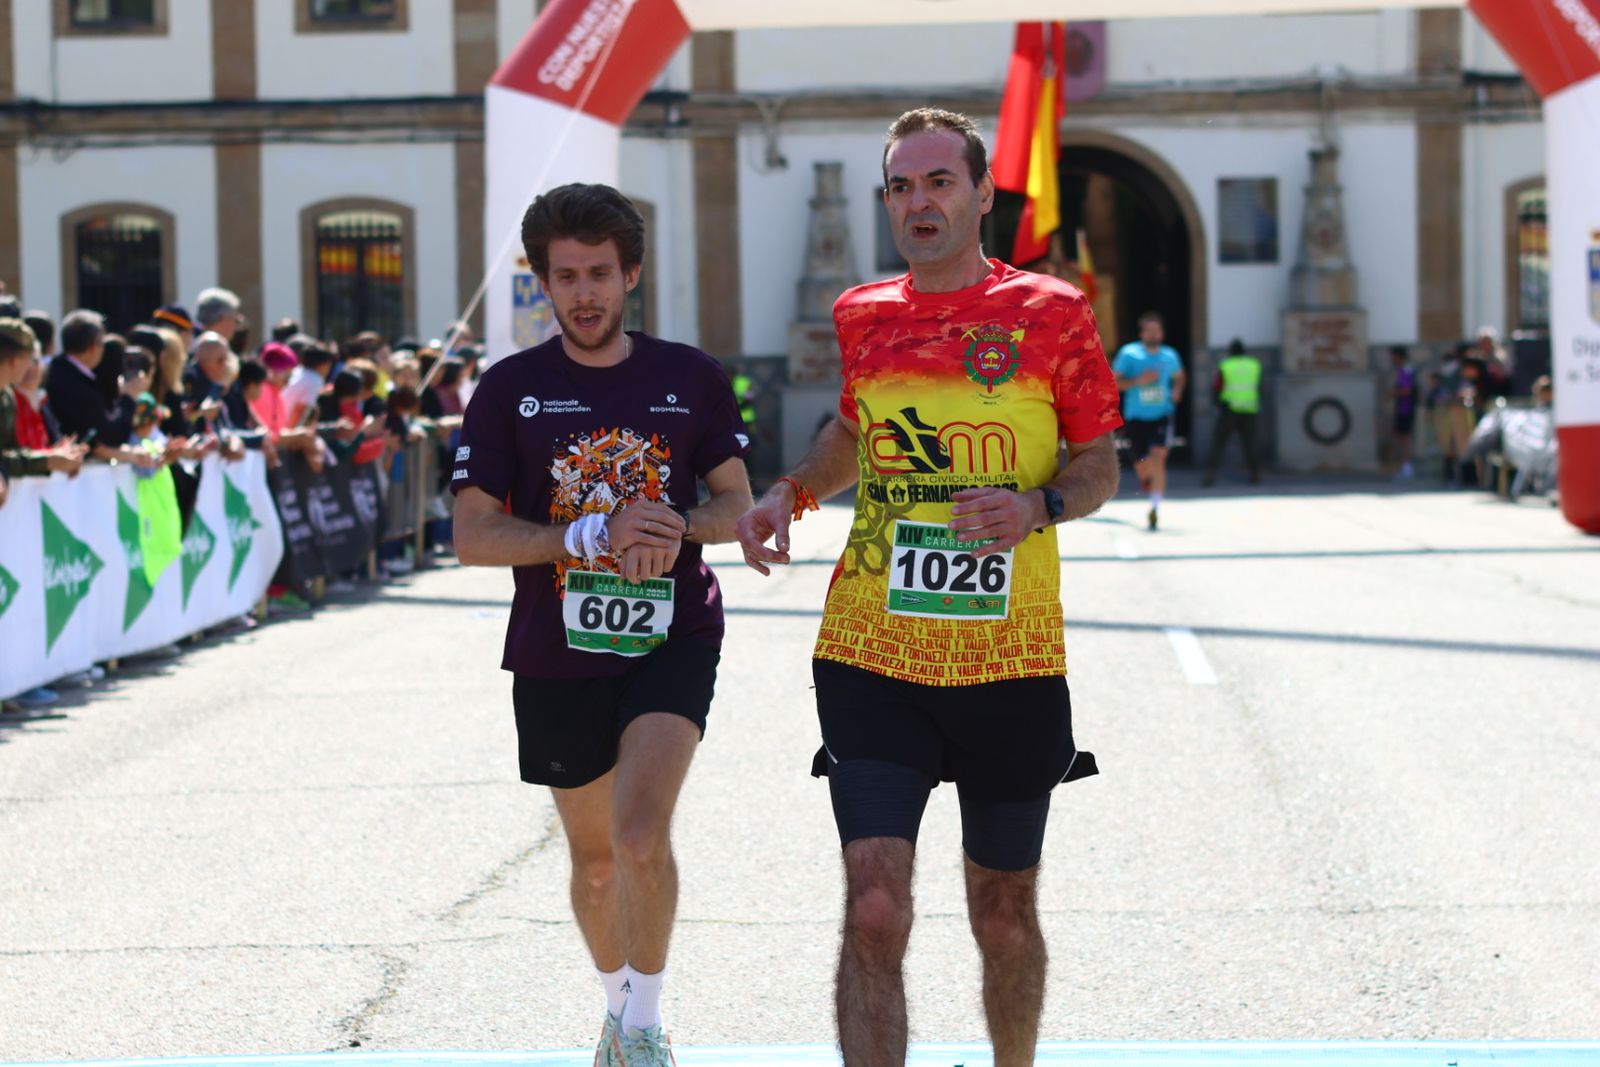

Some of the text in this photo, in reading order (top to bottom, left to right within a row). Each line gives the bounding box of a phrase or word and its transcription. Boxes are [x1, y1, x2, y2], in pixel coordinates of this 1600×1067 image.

[543, 405, 592, 413] nederlanden
[867, 483, 888, 503] SAN
[908, 484, 978, 503] FERNAN
[897, 524, 923, 544] XIV
[925, 537, 979, 549] CARRERA
[897, 549, 1006, 593] 1026
[596, 583, 644, 597] CARRERA
[578, 595, 656, 634] 602
[863, 636, 899, 656] VICTORIA
[952, 651, 986, 664] LEALTAD
[998, 644, 1023, 660] VALOR
[964, 639, 990, 651] VALOR
[859, 649, 905, 672] FORTALEZA
[910, 659, 944, 677] LEALTAD
[957, 664, 982, 678] VALOR
[986, 661, 1004, 676] POR
[1007, 660, 1018, 673] EL
[1021, 656, 1054, 671] TRABAJO
